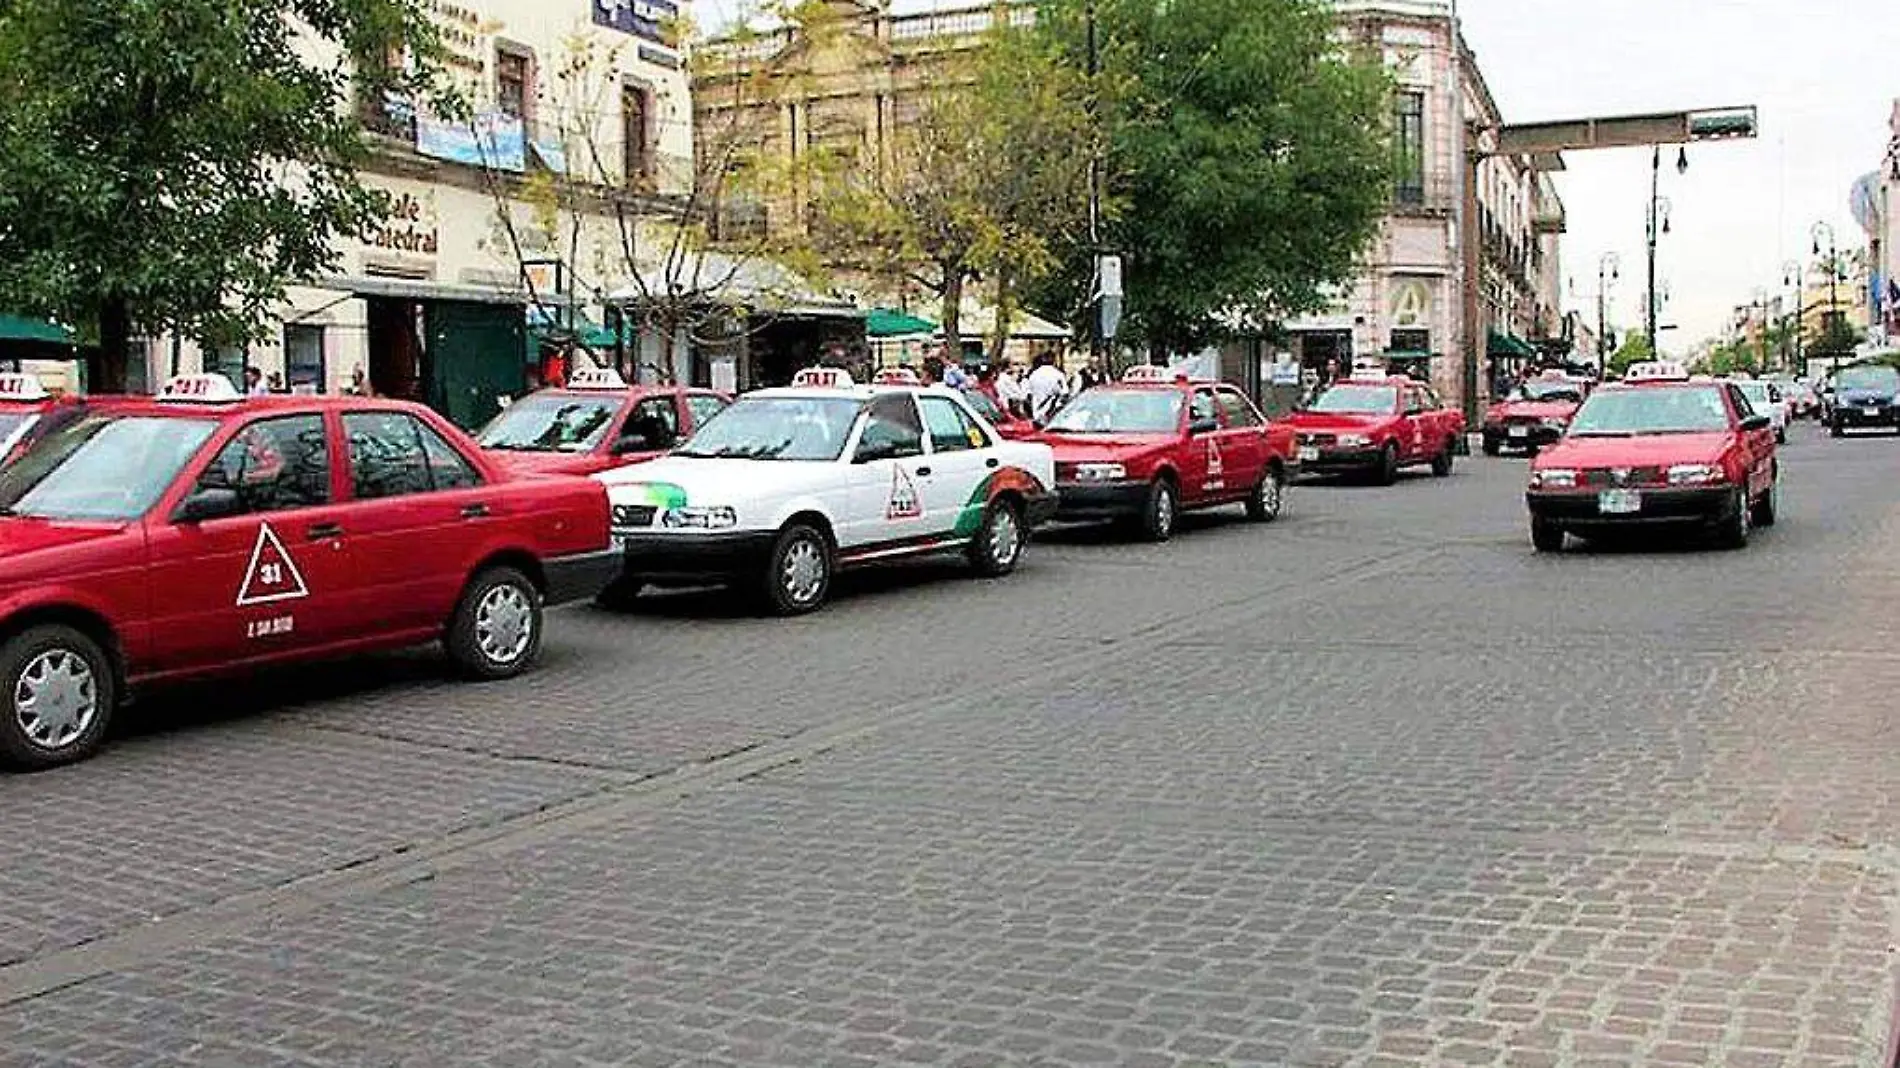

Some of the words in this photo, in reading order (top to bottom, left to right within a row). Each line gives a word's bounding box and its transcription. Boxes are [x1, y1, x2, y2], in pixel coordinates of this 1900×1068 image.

[360, 222, 437, 252] Catedral
[806, 372, 836, 386] TAXI
[260, 563, 282, 584] 31
